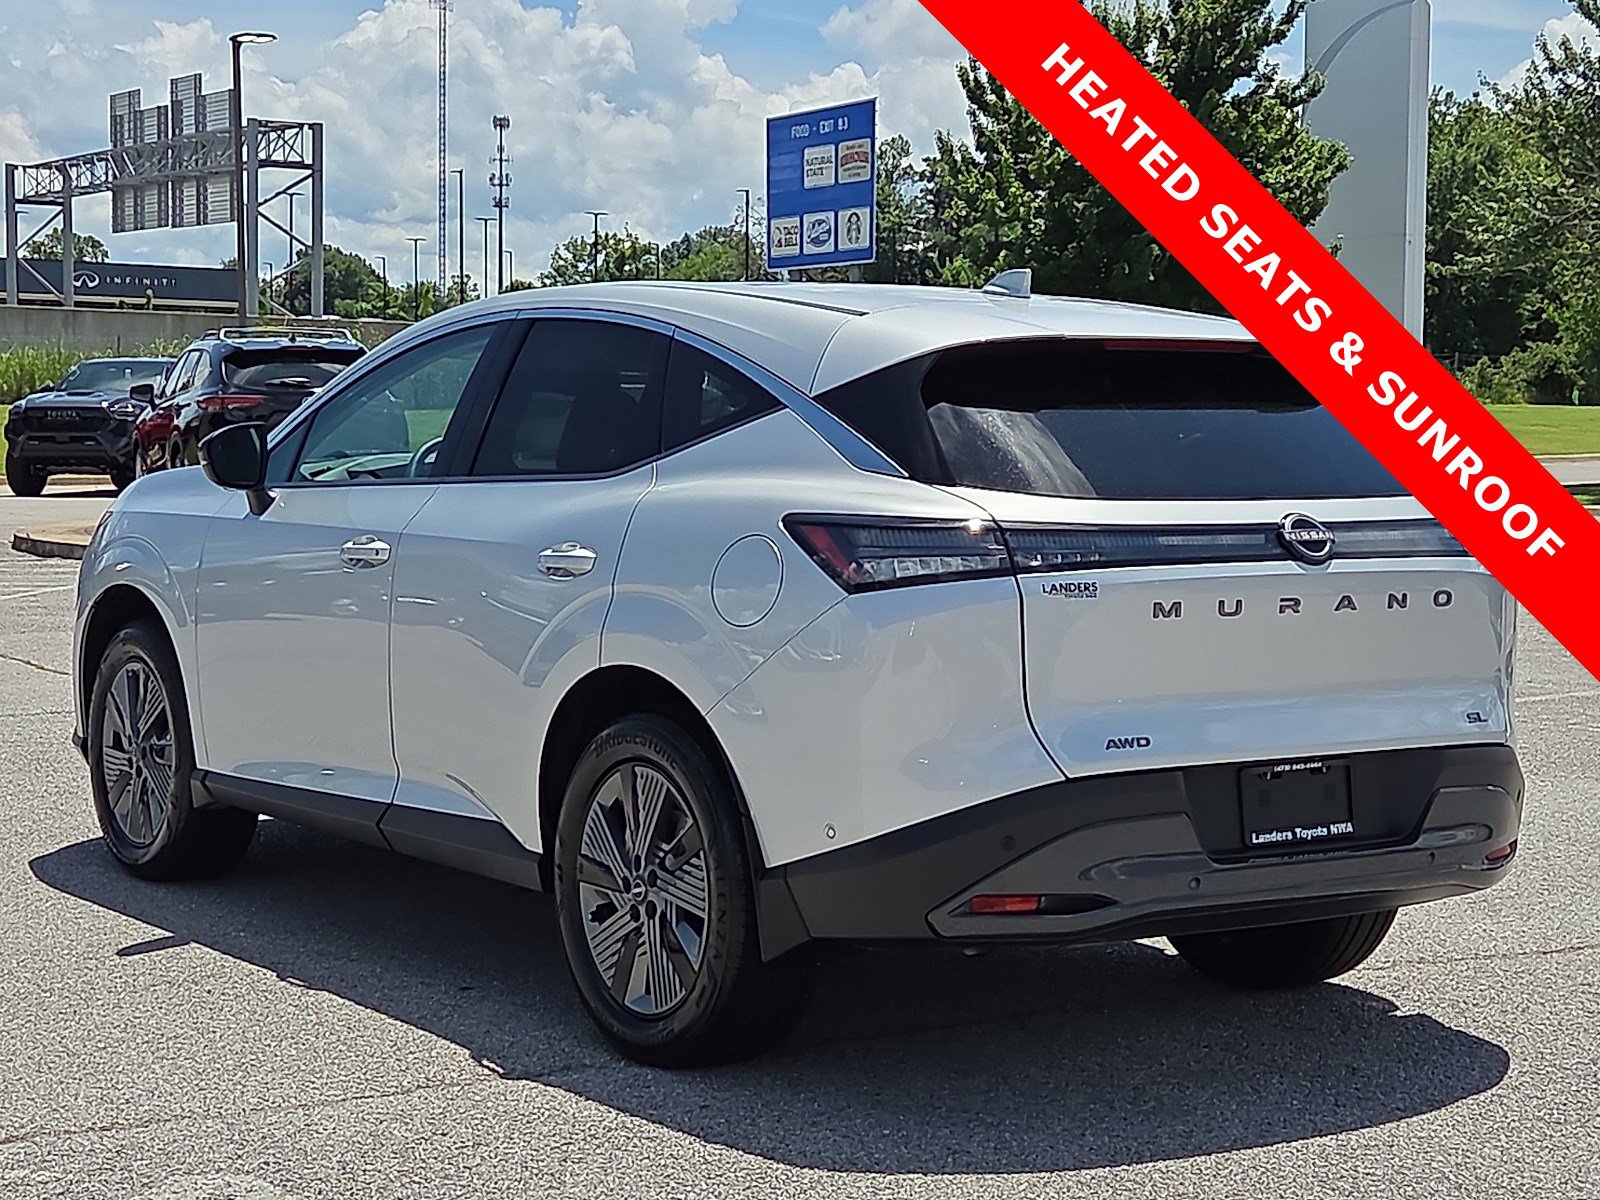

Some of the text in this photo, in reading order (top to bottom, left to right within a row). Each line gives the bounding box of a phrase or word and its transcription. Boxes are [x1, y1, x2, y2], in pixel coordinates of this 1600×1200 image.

[791, 123, 811, 139] FOOD
[819, 118, 834, 134] EXIT
[805, 155, 834, 167] NATURAL
[806, 167, 825, 178] STATE
[783, 236, 799, 247] BELL
[105, 275, 177, 287] INFINITI
[47, 410, 77, 418] TOYOTA
[1285, 529, 1334, 541] NISSAN
[1041, 581, 1098, 595] LANDERS
[1152, 589, 1454, 619] MURANO
[1466, 711, 1489, 724] SL
[1105, 735, 1151, 750] AWD
[1251, 821, 1354, 844] Landers Toyota NWA
